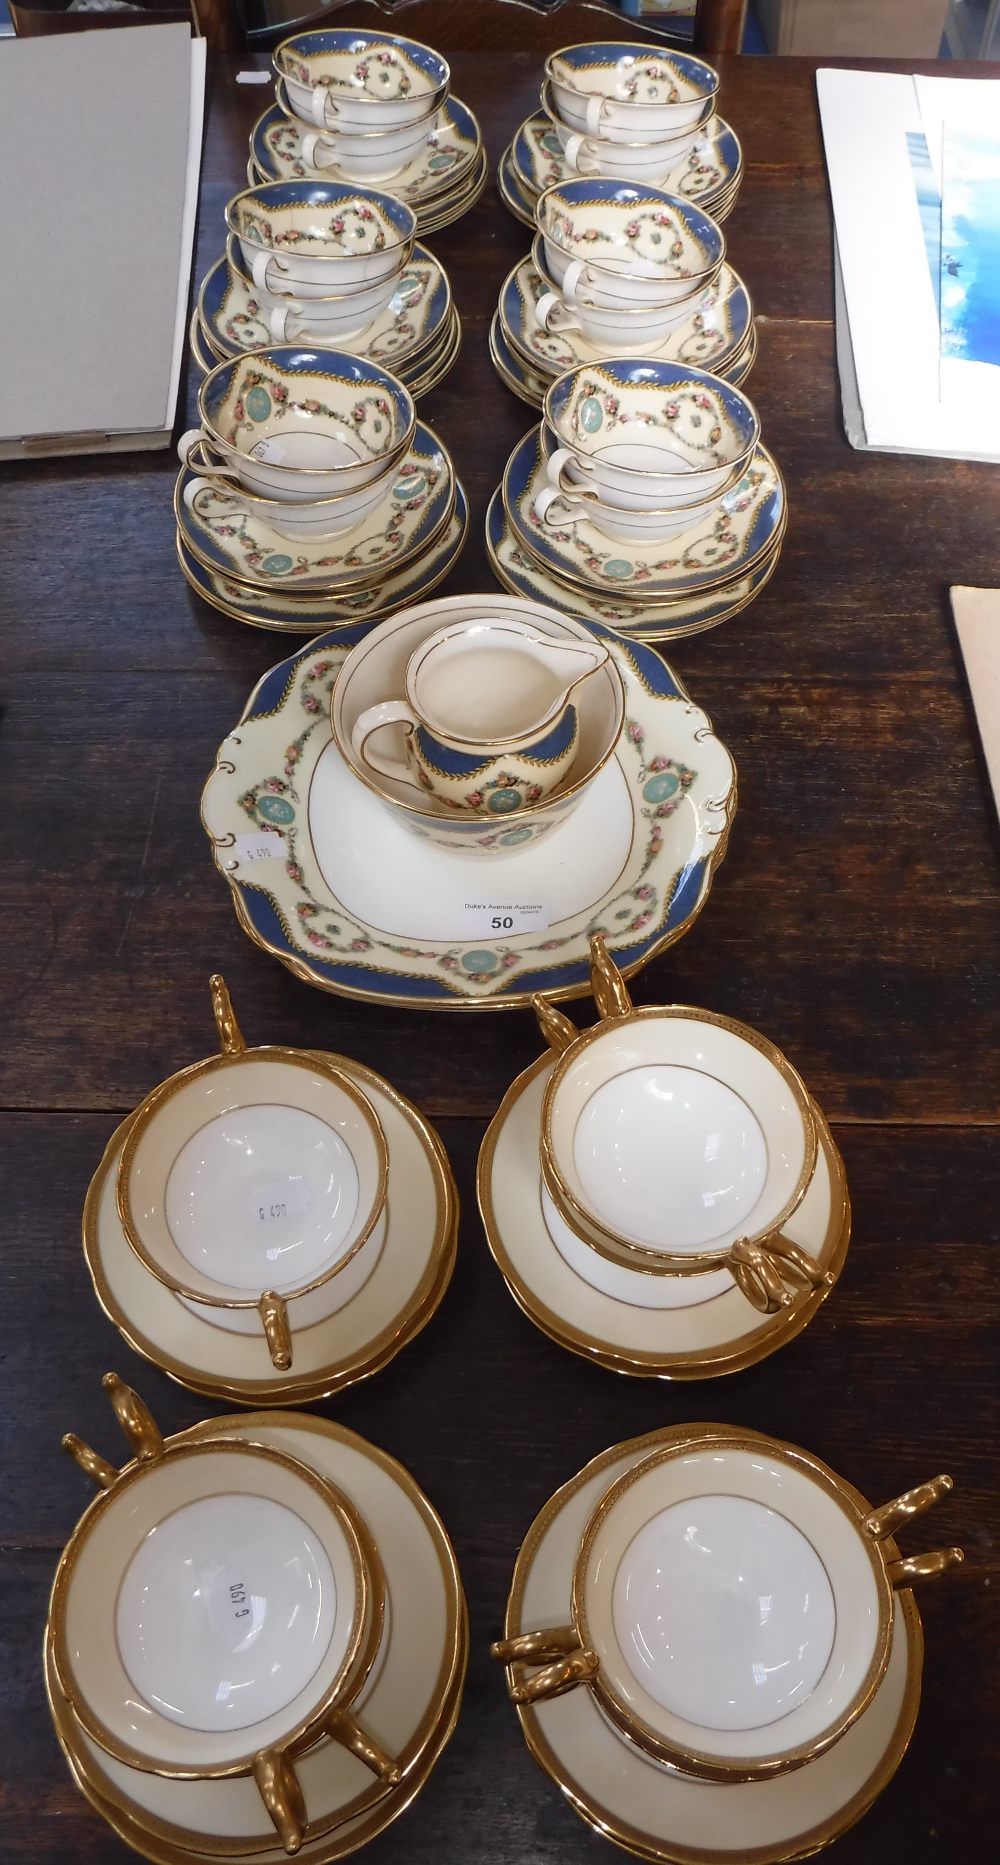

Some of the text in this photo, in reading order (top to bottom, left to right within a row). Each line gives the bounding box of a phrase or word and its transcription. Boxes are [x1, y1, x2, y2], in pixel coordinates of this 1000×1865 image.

[491, 916, 514, 929] 50
[229, 1583, 250, 1618] G 490
